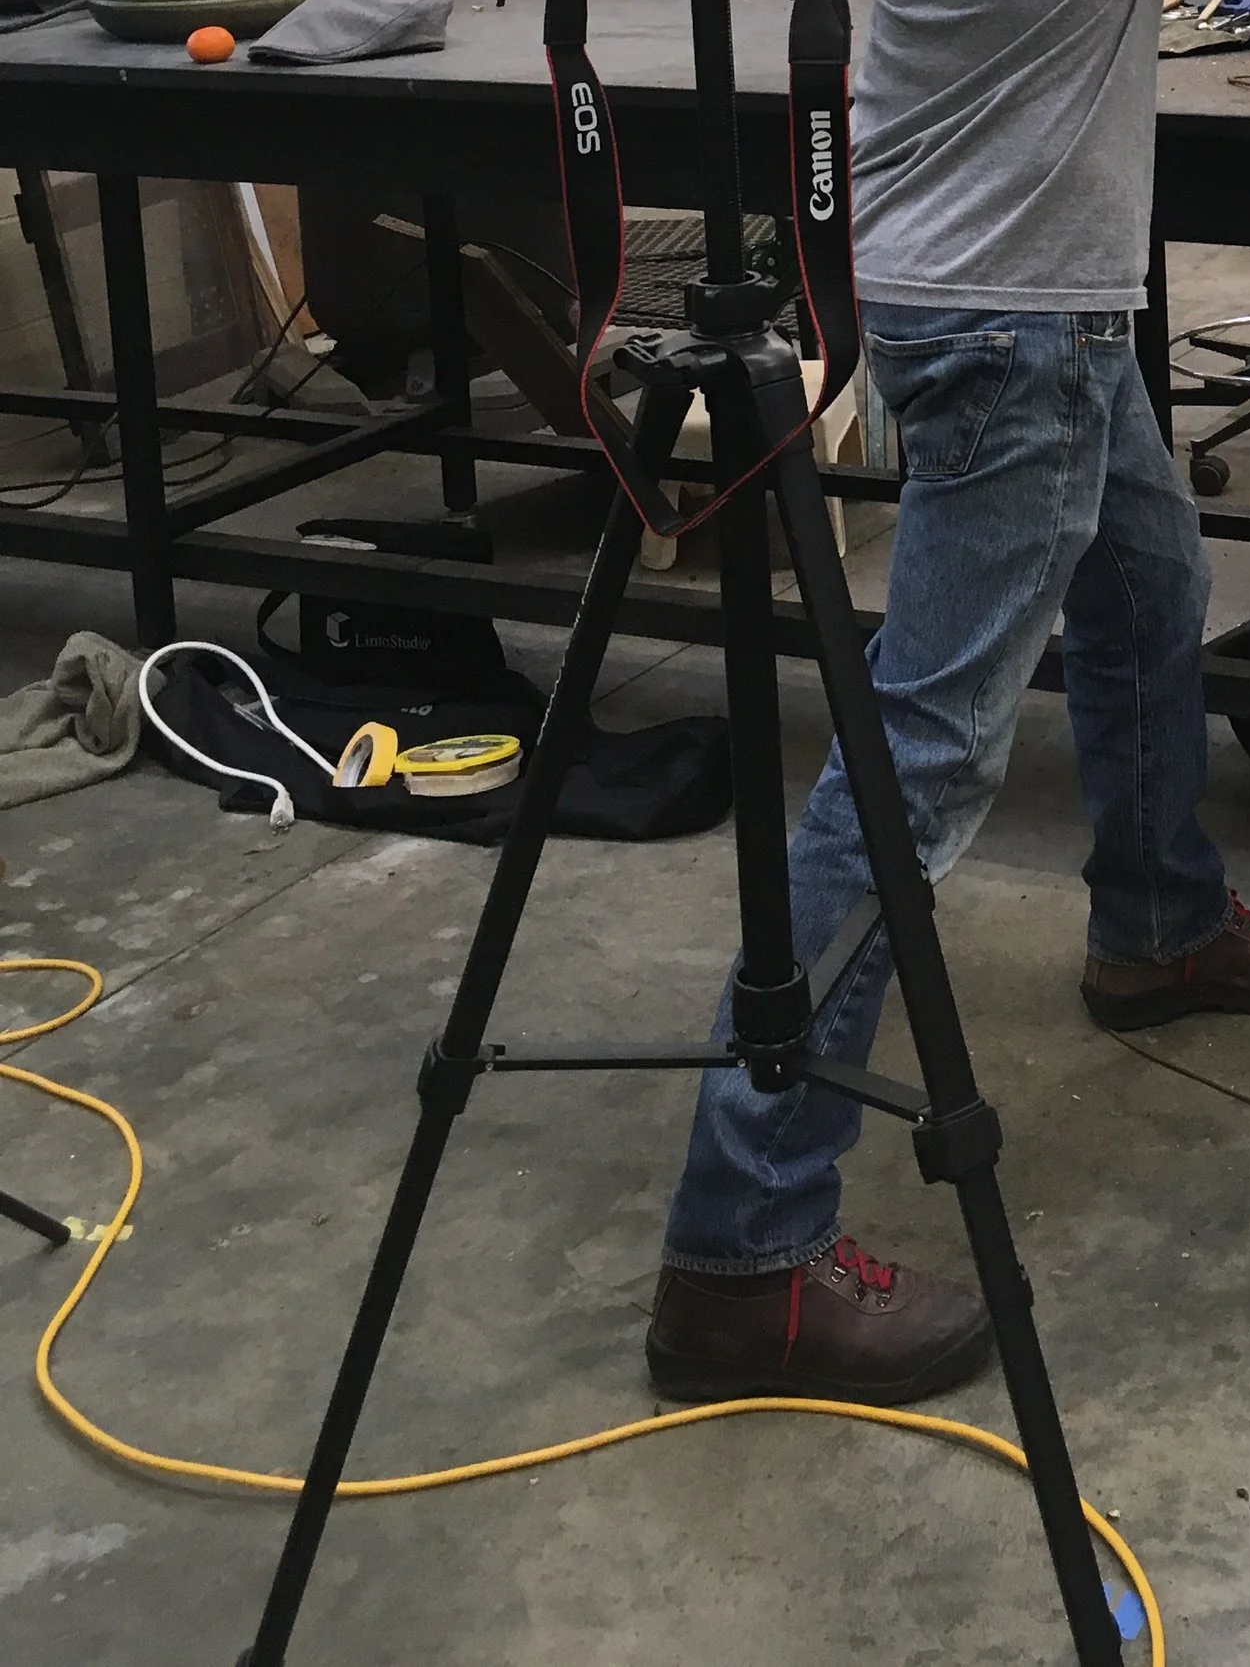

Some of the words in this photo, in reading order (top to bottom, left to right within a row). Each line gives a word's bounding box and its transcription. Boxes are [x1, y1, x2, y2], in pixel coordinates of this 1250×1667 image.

[571, 82, 601, 154] EOS
[809, 110, 835, 221] Canon
[355, 633, 430, 651] LimoStudio
